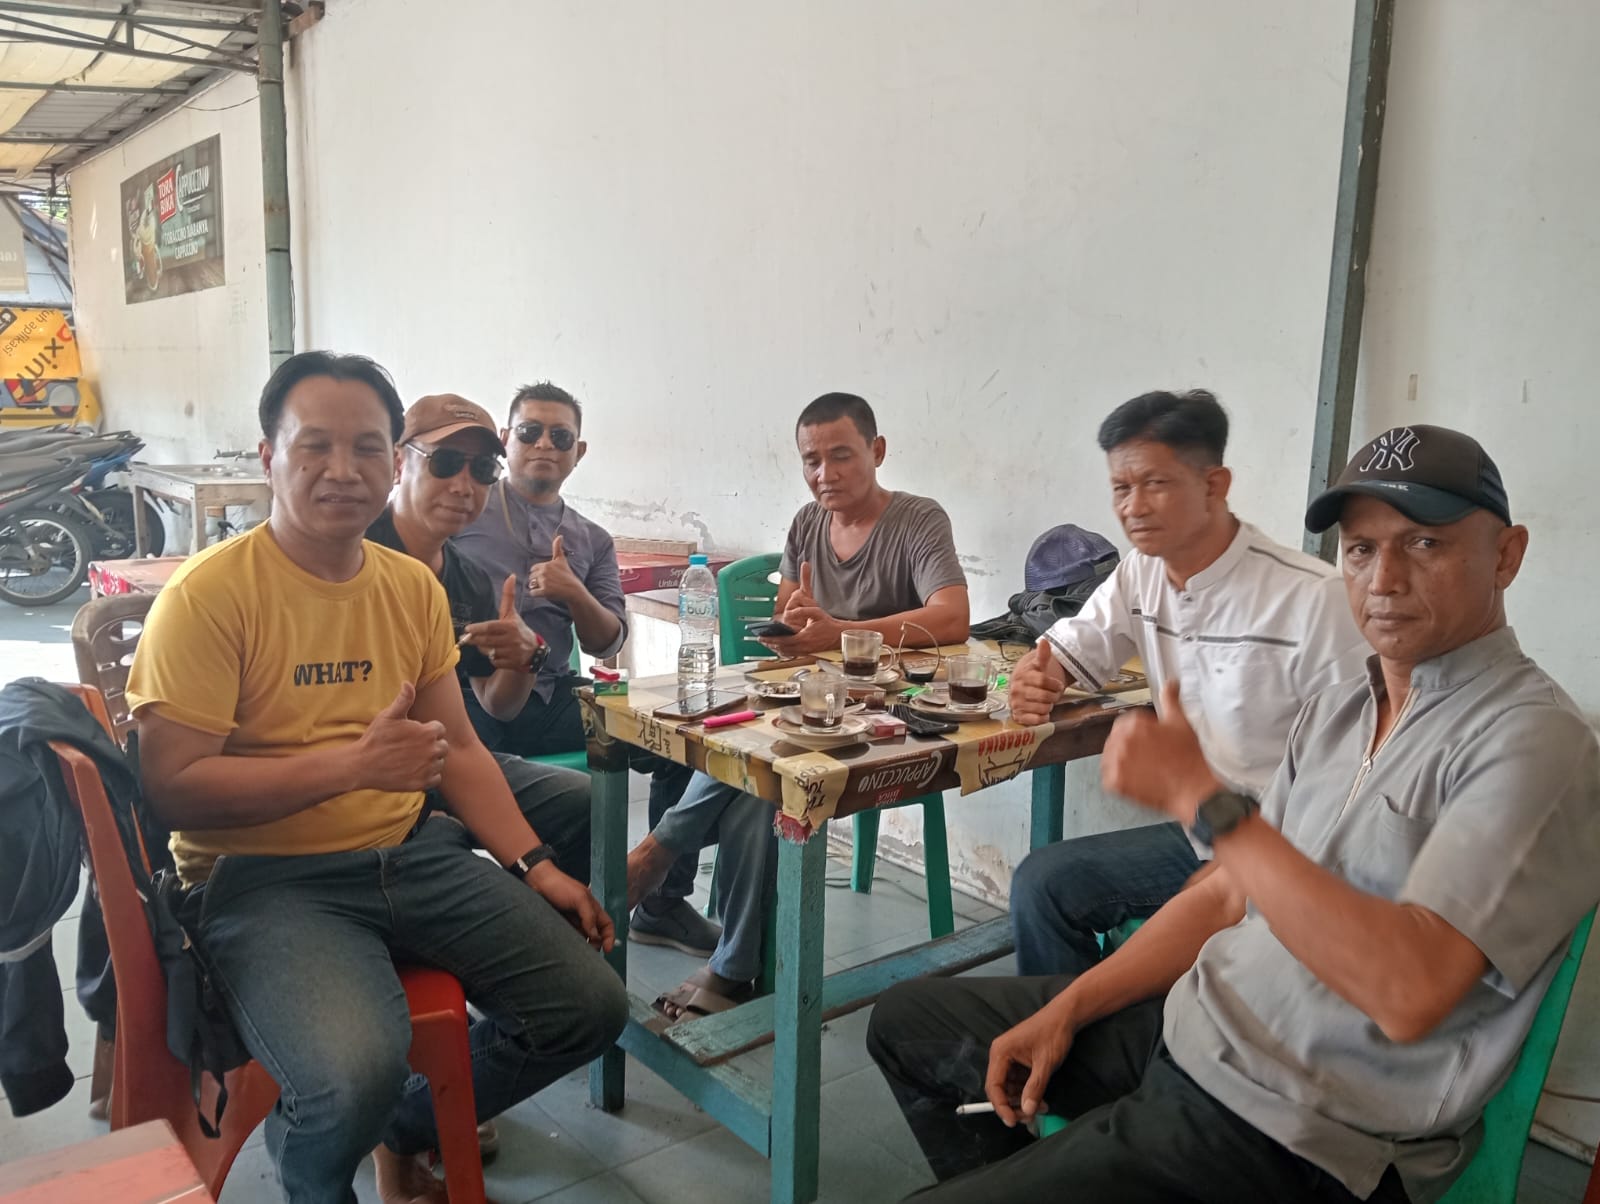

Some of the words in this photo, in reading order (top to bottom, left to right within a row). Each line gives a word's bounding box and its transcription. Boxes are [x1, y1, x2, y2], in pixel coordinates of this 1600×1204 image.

[158, 177, 174, 201] TORA
[160, 193, 176, 216] BIKA
[293, 660, 373, 686] WHAT?
[978, 730, 1036, 757] TORABIKA
[858, 750, 943, 793] CAPPUCCINO
